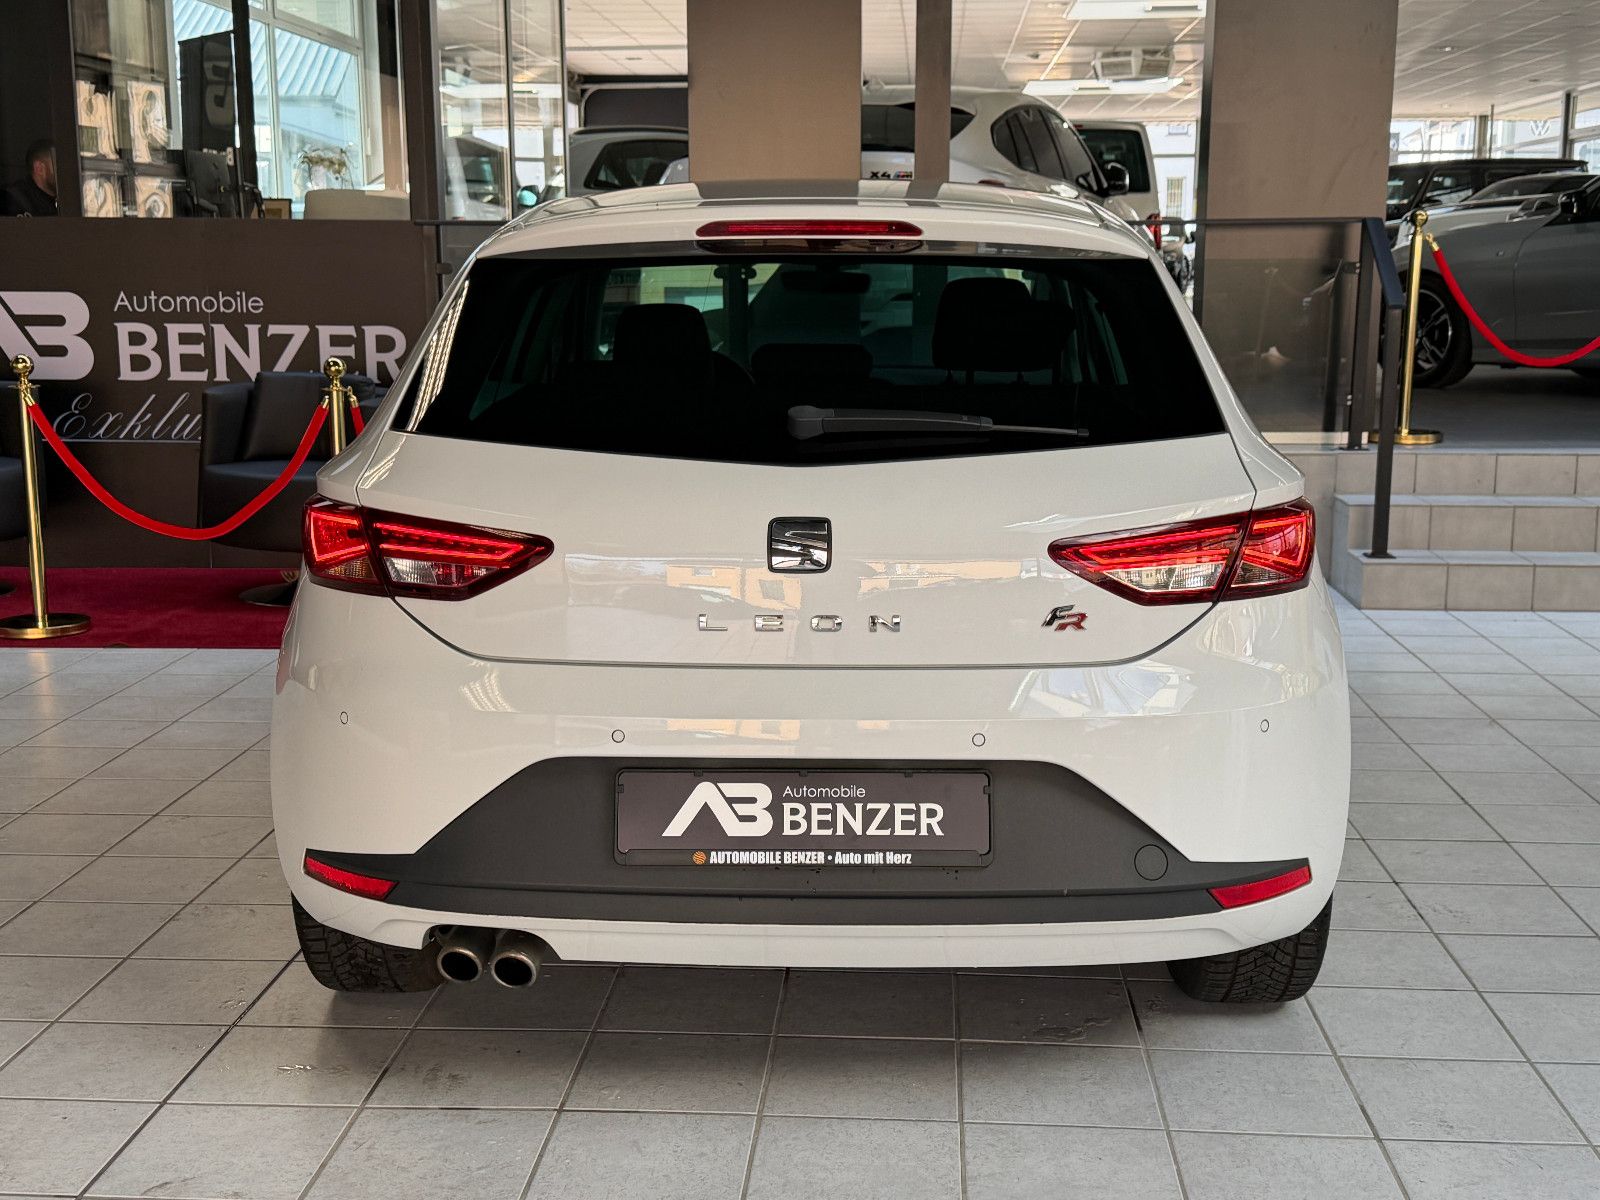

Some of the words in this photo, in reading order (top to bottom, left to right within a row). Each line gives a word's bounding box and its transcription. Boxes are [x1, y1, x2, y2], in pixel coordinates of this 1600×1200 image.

[113, 290, 265, 314] Automobile
[698, 613, 903, 633] LEON
[1041, 603, 1088, 633] FR
[782, 785, 866, 799] Automobile
[781, 802, 945, 837] BENZER
[709, 851, 782, 865] AUTOMOBILE
[783, 851, 825, 865] BENZER
[834, 851, 863, 865] Auto
[863, 851, 885, 865] mit
[885, 851, 912, 865] Herz
